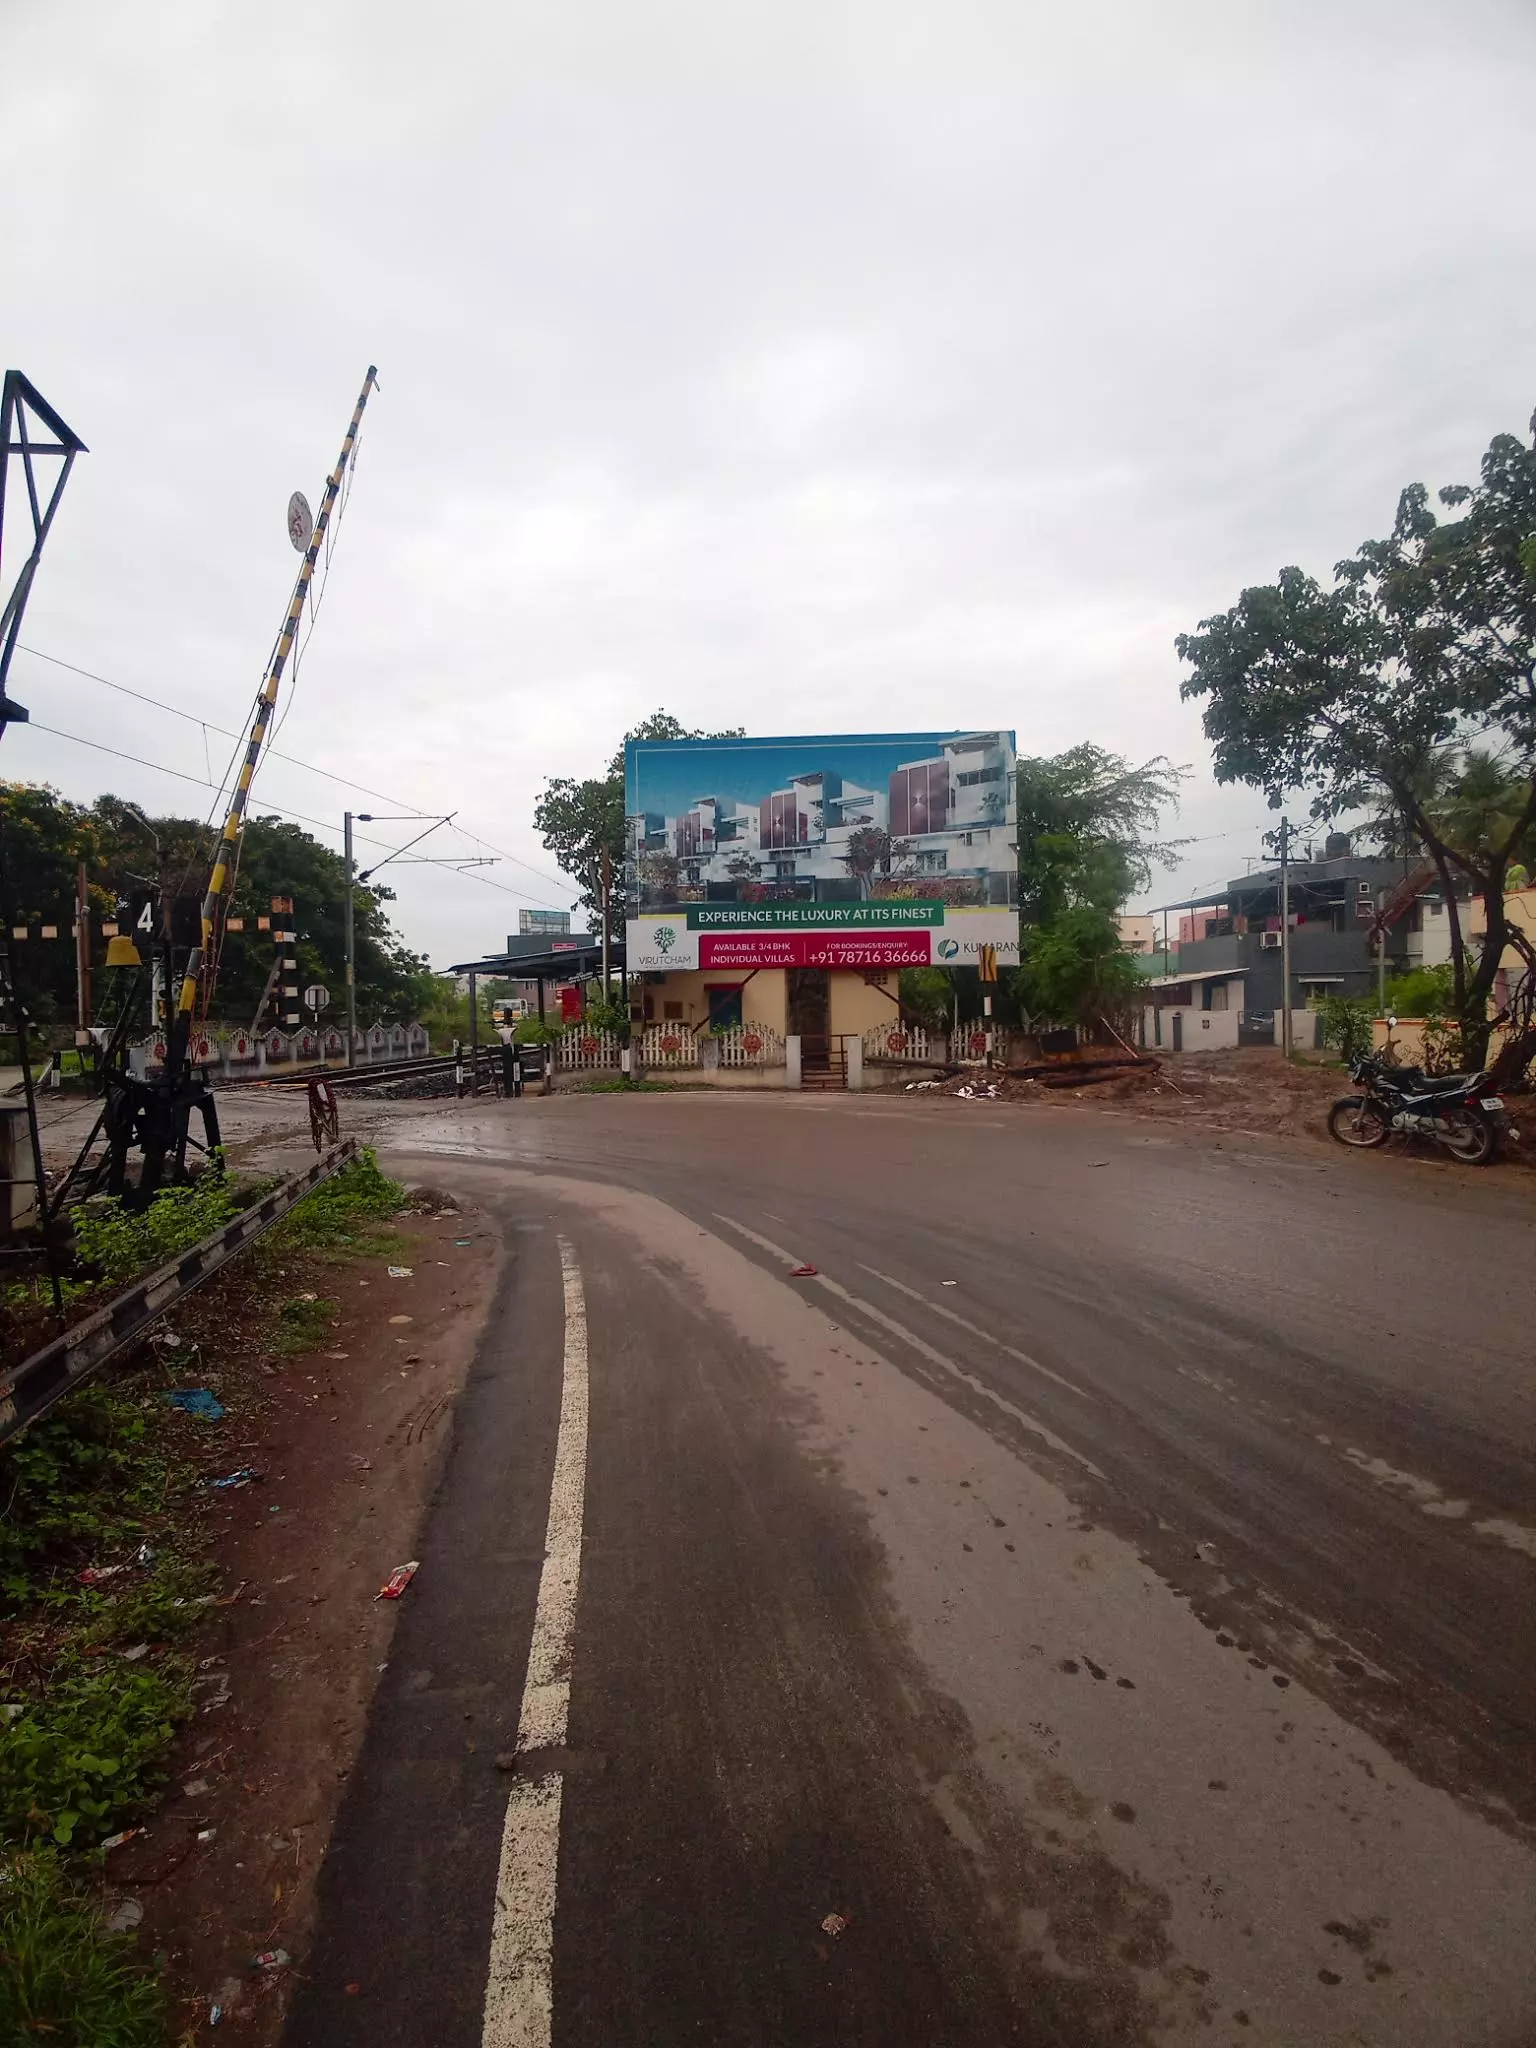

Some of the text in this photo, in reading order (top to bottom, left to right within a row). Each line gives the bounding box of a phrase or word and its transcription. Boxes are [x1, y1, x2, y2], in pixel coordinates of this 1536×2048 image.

[137, 902, 154, 933] 4
[698, 908, 933, 923] EXPERIENCE THE LUXURY AT ITS FINEST
[713, 942, 791, 951] AVAILABLE 3/4 BHK
[638, 955, 692, 965] VIRUTCHAM
[710, 954, 796, 964] INDIVIDUAL VILLAS
[809, 950, 928, 963] +91 78716 36666
